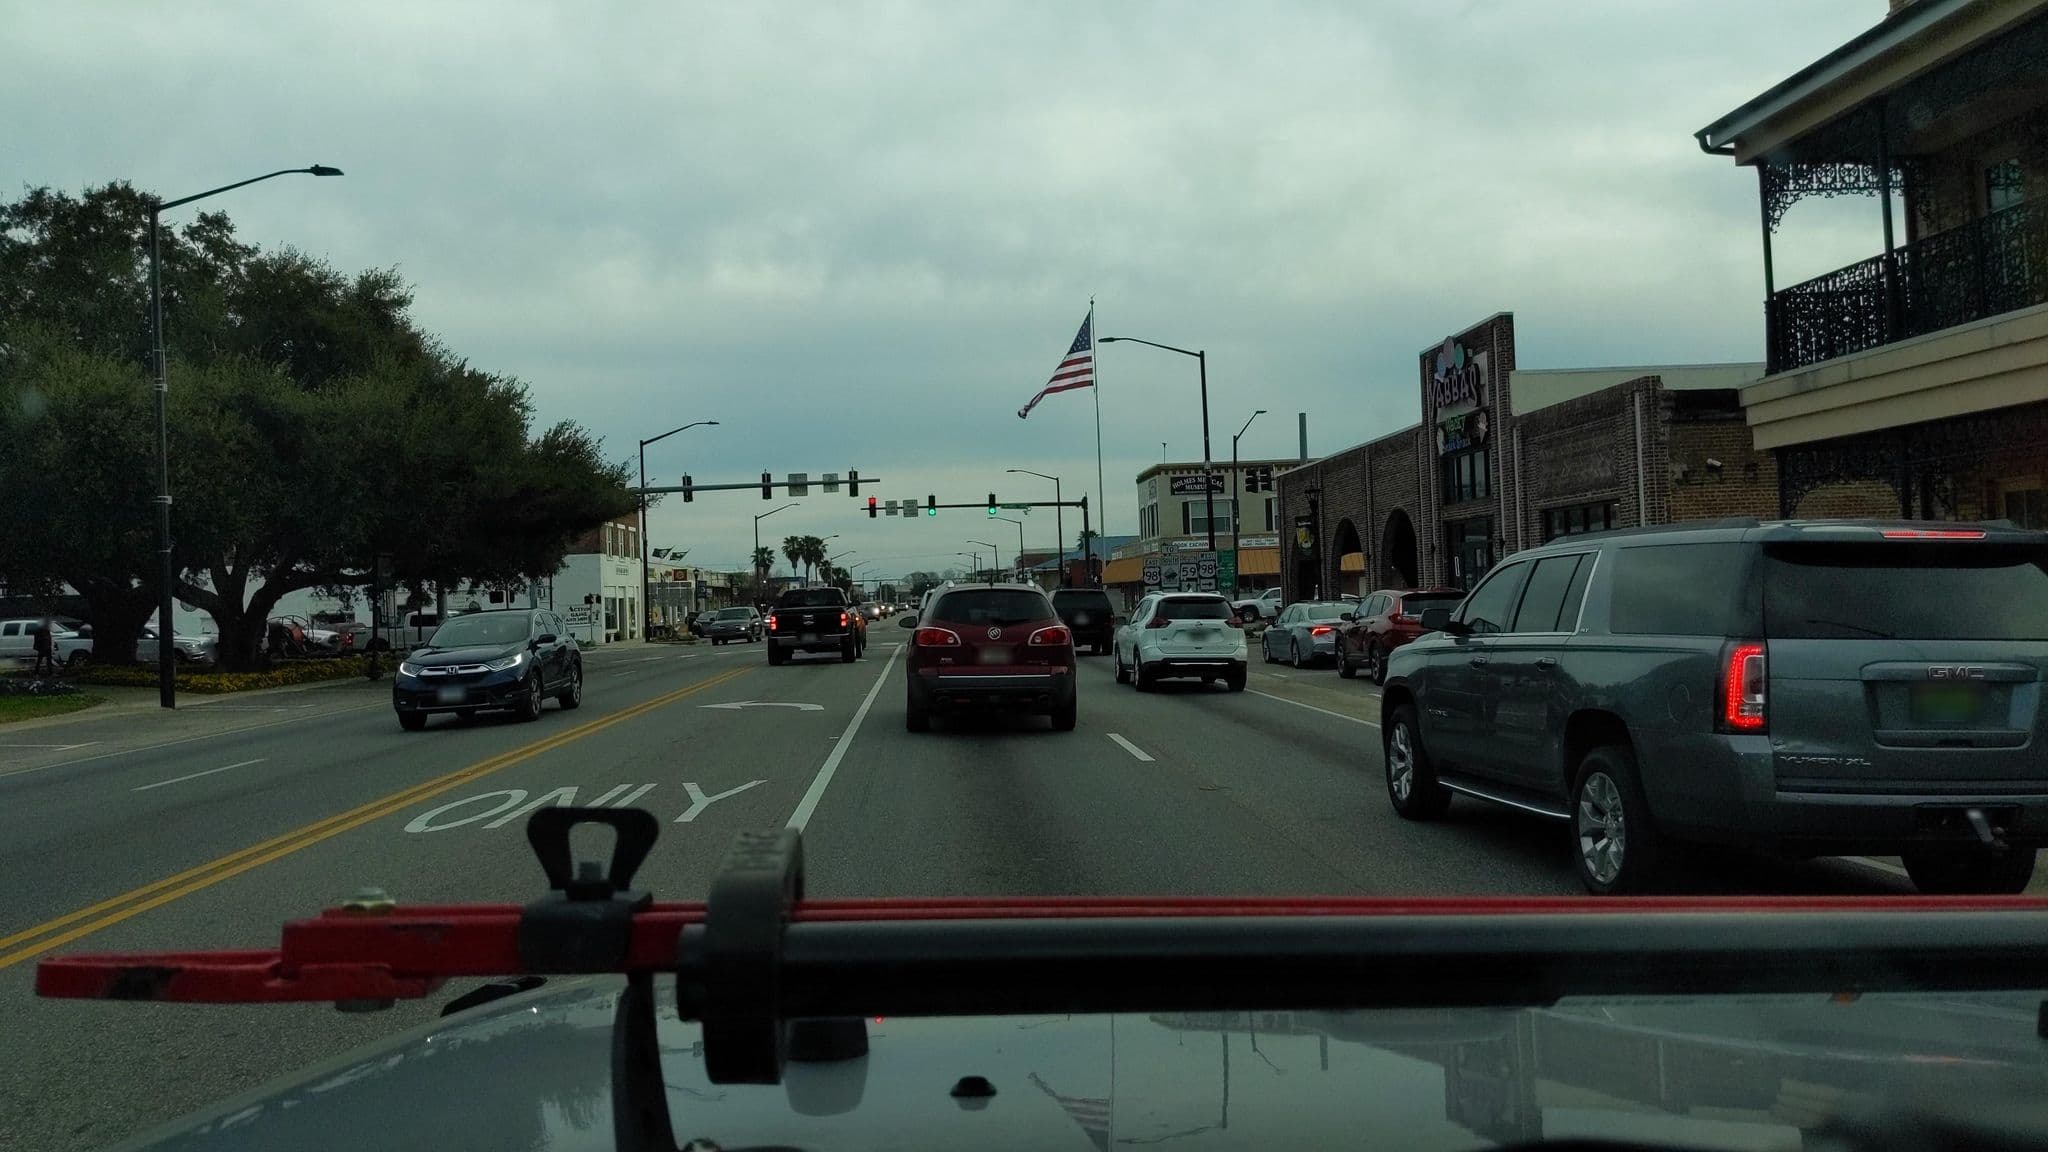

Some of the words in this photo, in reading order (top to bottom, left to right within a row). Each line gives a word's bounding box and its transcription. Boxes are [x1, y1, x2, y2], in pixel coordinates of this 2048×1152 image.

[1172, 477, 1196, 489] HOLMES
[1181, 567, 1196, 577] 59
[1201, 564, 1213, 575] 98
[1145, 571, 1159, 581] 98
[1927, 664, 1985, 679] GMC
[1846, 757, 1872, 767] XL
